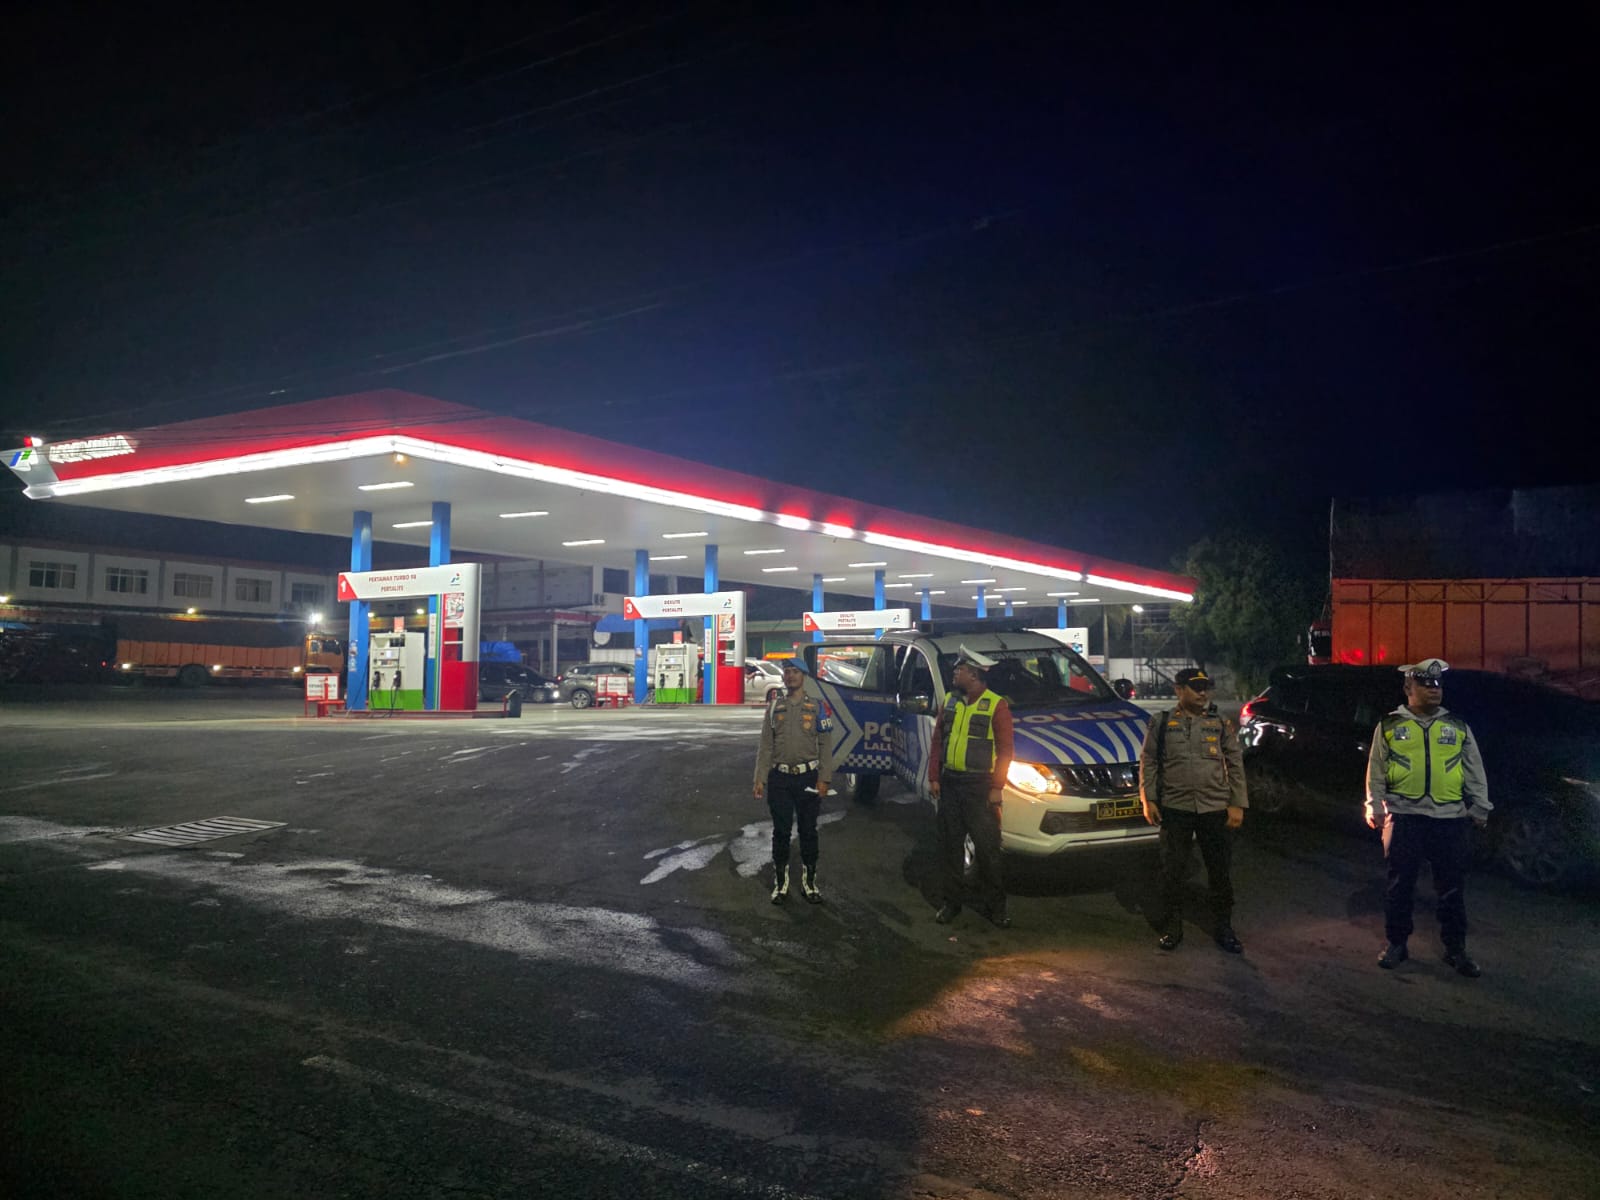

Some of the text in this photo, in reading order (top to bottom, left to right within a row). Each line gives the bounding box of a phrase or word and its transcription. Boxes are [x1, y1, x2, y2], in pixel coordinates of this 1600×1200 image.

[340, 580, 347, 593] 1
[626, 603, 633, 614] 3
[1012, 709, 1138, 724] OLISI
